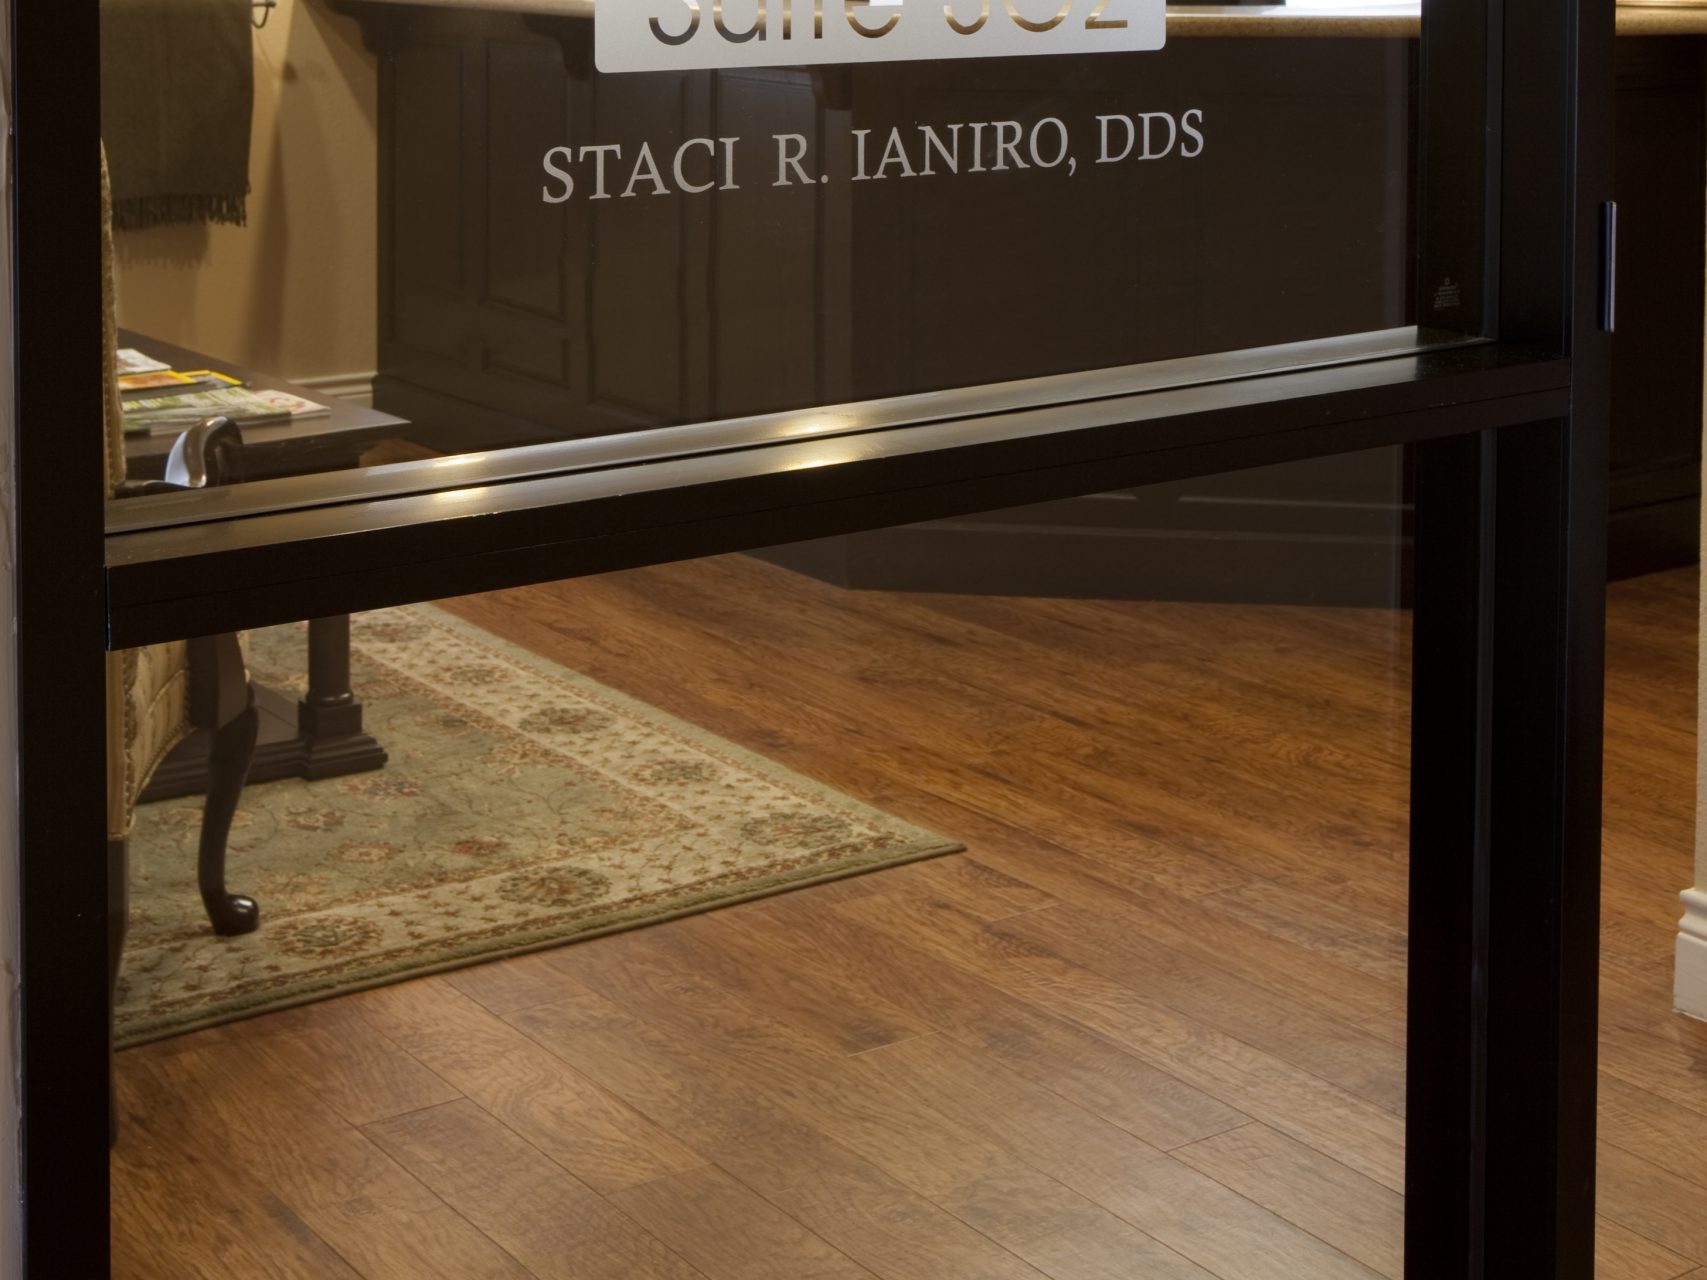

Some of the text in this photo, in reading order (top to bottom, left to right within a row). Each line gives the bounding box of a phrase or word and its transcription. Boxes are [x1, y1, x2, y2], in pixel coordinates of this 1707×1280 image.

[541, 109, 1204, 204] STACI R. IANIRO, DDS
